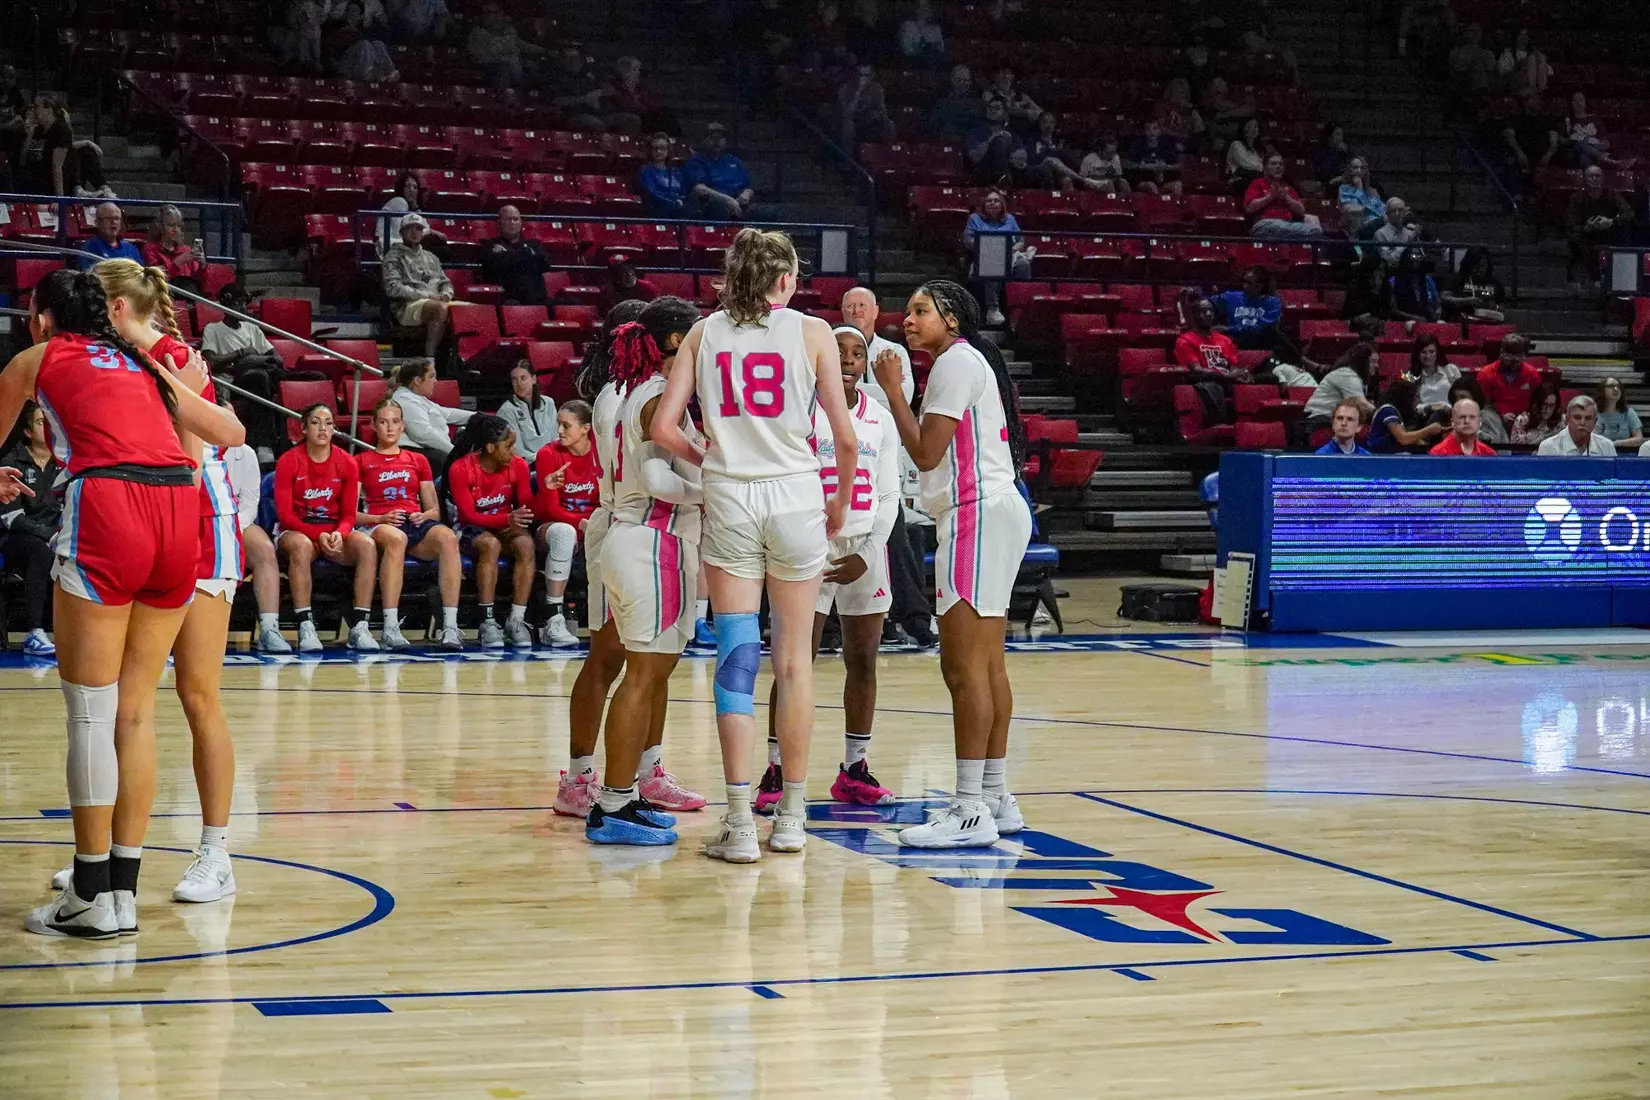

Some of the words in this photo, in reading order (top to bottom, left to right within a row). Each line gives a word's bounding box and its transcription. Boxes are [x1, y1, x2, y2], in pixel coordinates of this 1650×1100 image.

[715, 351, 785, 418] 18
[378, 470, 411, 483] Liberty
[303, 487, 333, 501] Liberty
[564, 481, 595, 495] Liberty
[476, 494, 506, 507] Liberty
